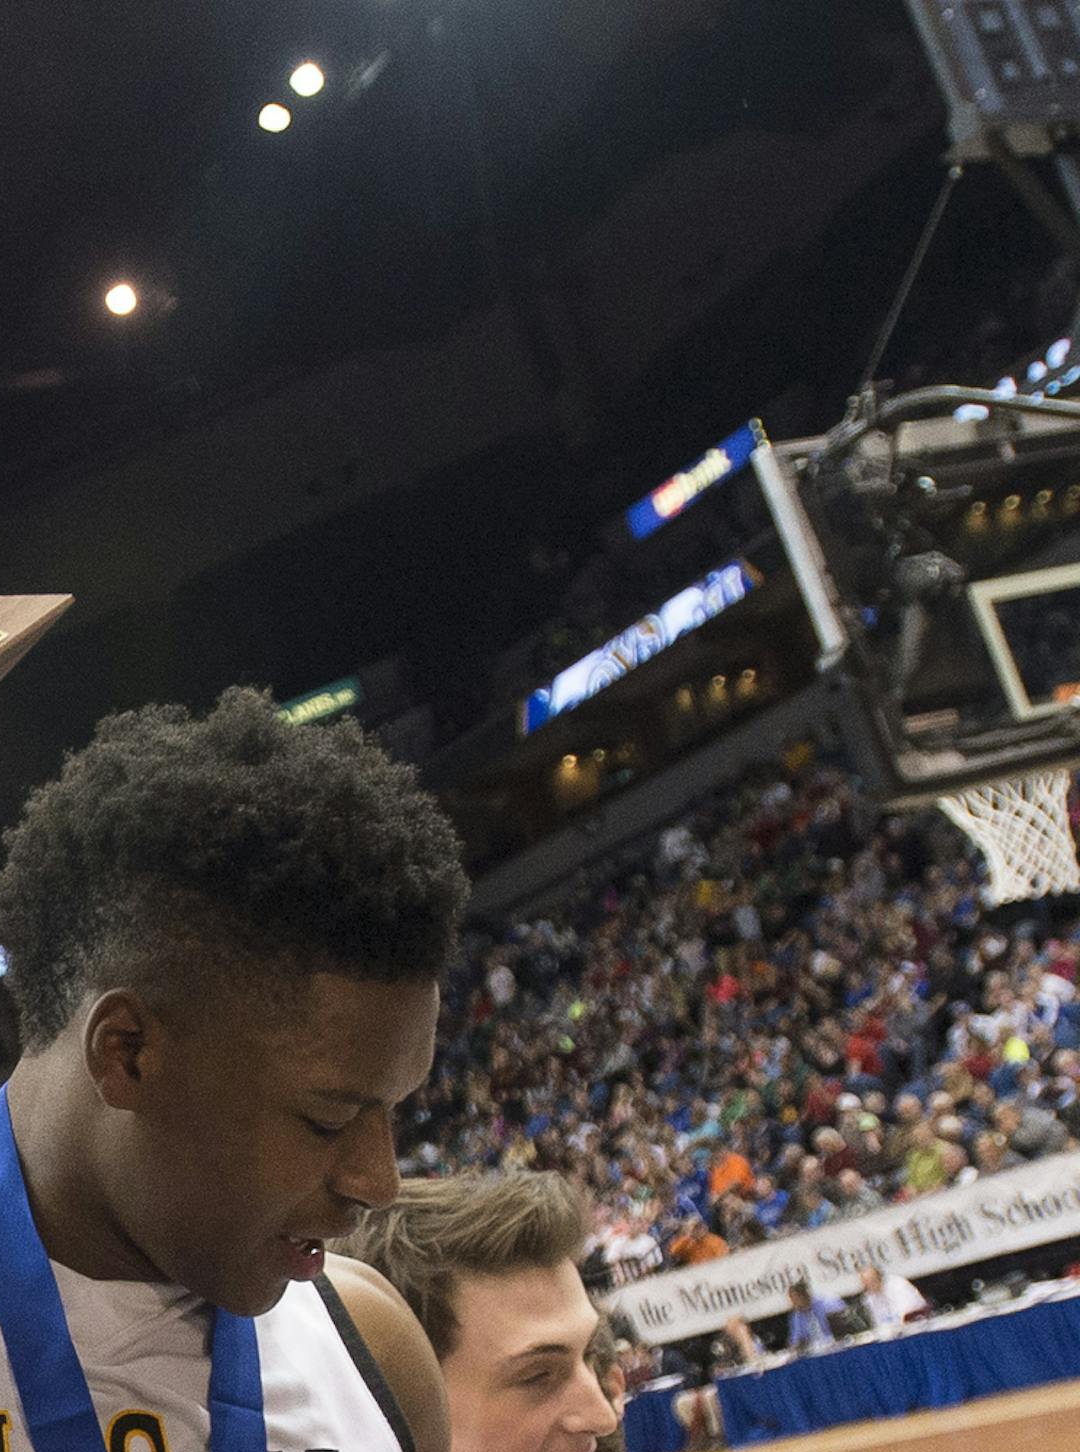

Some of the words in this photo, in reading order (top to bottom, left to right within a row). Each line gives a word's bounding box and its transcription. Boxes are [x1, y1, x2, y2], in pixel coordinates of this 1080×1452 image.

[638, 1292, 675, 1330] the
[677, 1258, 812, 1318] Minnesota
[817, 1235, 891, 1278] State
[892, 1206, 975, 1259] High
[978, 1184, 1080, 1229] Schoo
